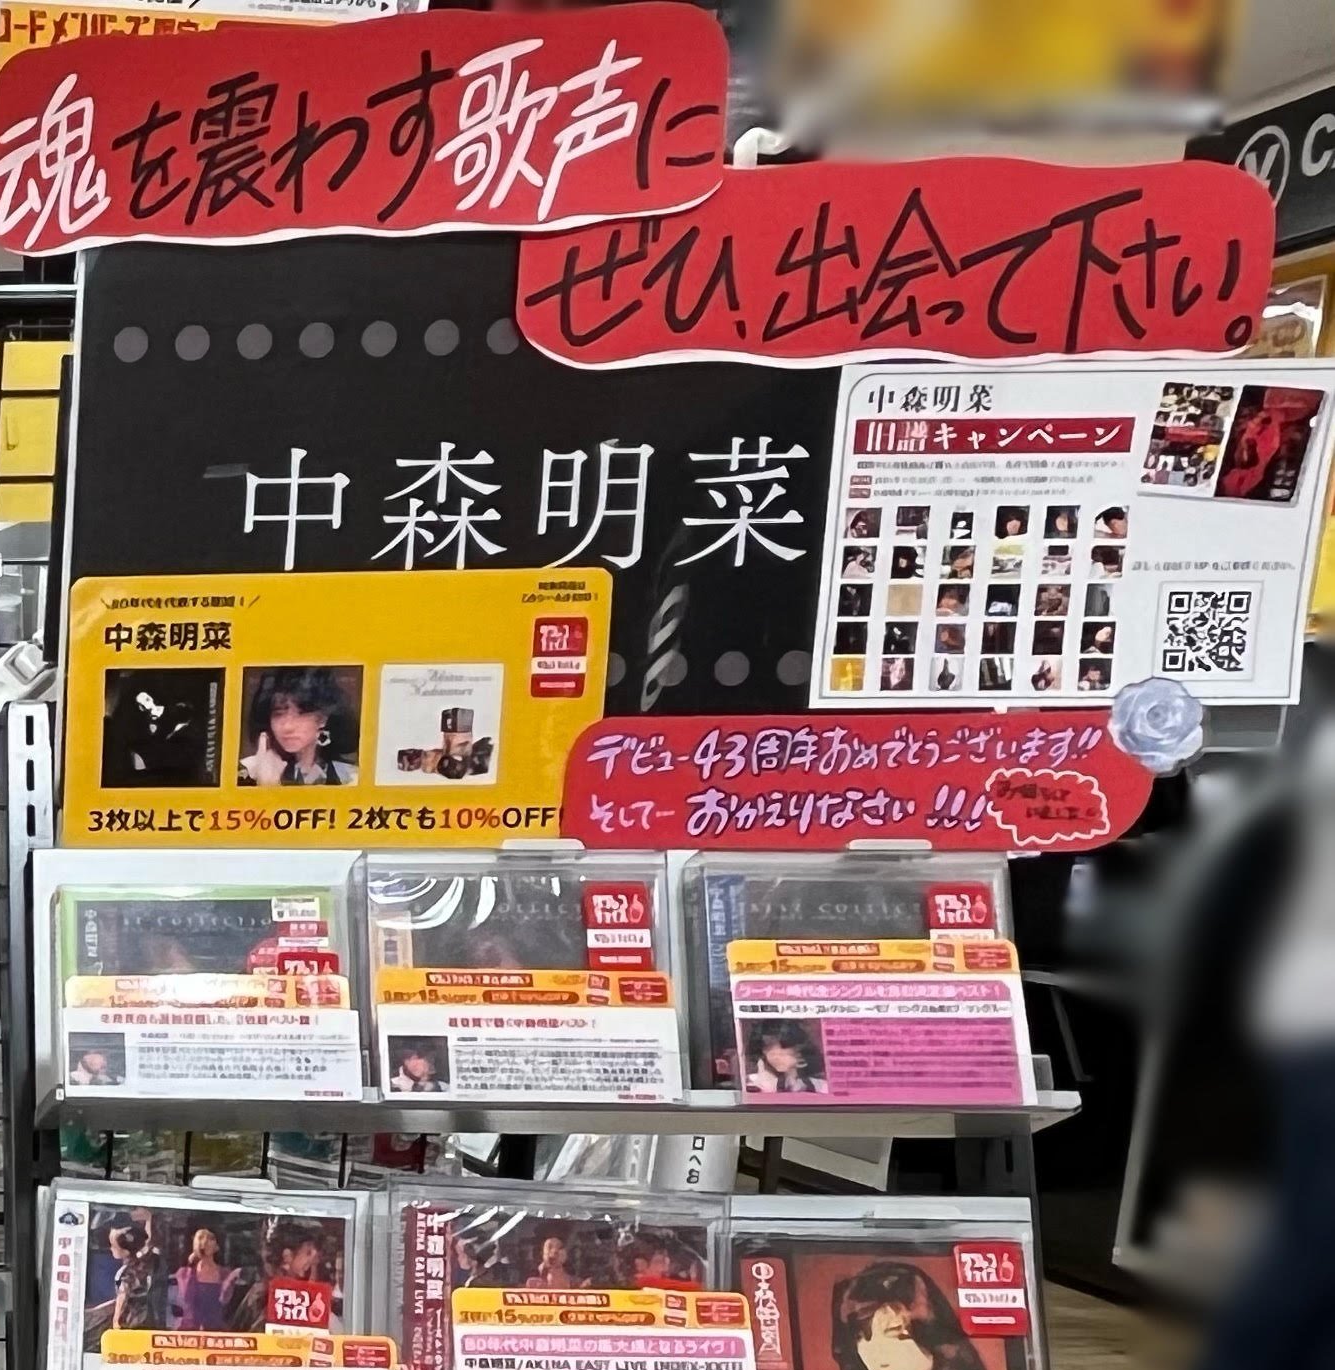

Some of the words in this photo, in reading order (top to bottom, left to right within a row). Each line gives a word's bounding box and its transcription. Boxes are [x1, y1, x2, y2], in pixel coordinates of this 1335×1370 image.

[868, 385, 995, 414] 中森明菜
[242, 435, 811, 571] 中森明菜
[104, 622, 232, 653] 中森明菜
[88, 807, 337, 834] 3枚以上で15%OFF!
